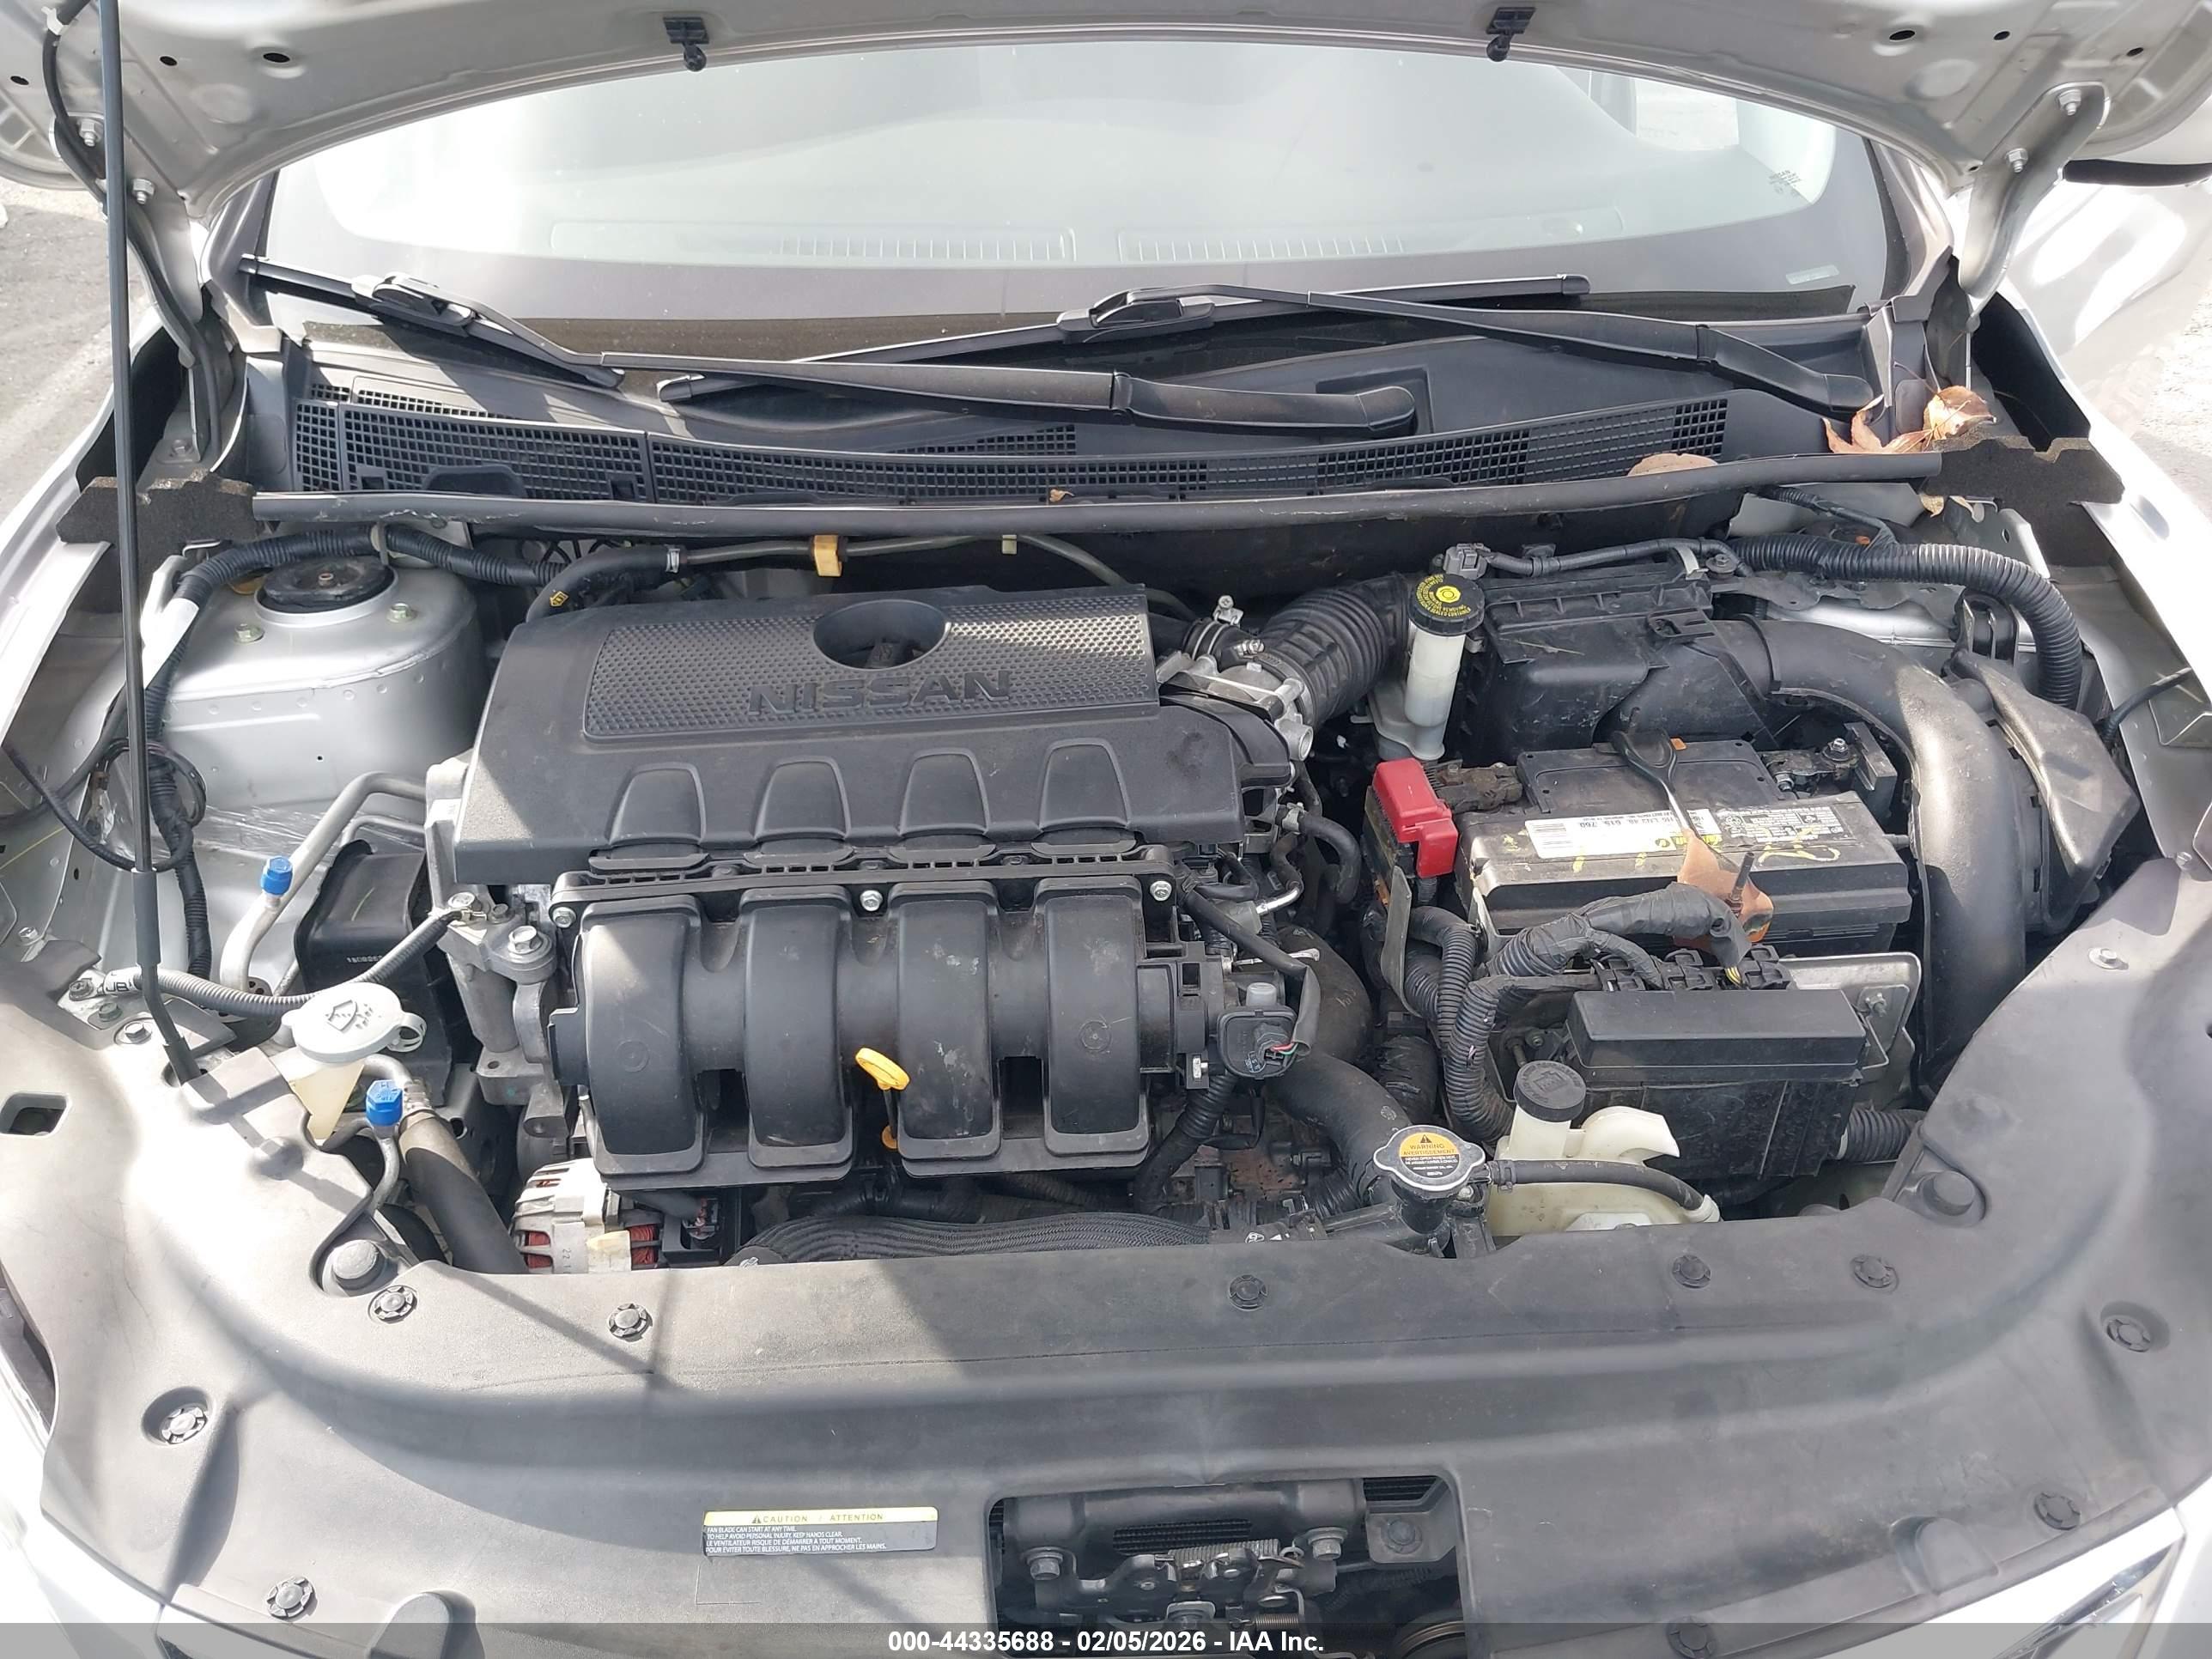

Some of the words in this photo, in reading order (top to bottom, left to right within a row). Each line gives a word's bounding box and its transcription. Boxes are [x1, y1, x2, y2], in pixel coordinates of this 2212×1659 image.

[748, 670, 1011, 715] NISSAN
[763, 1515, 808, 1523] CAUTION
[830, 1513, 884, 1522] ATTENTION
